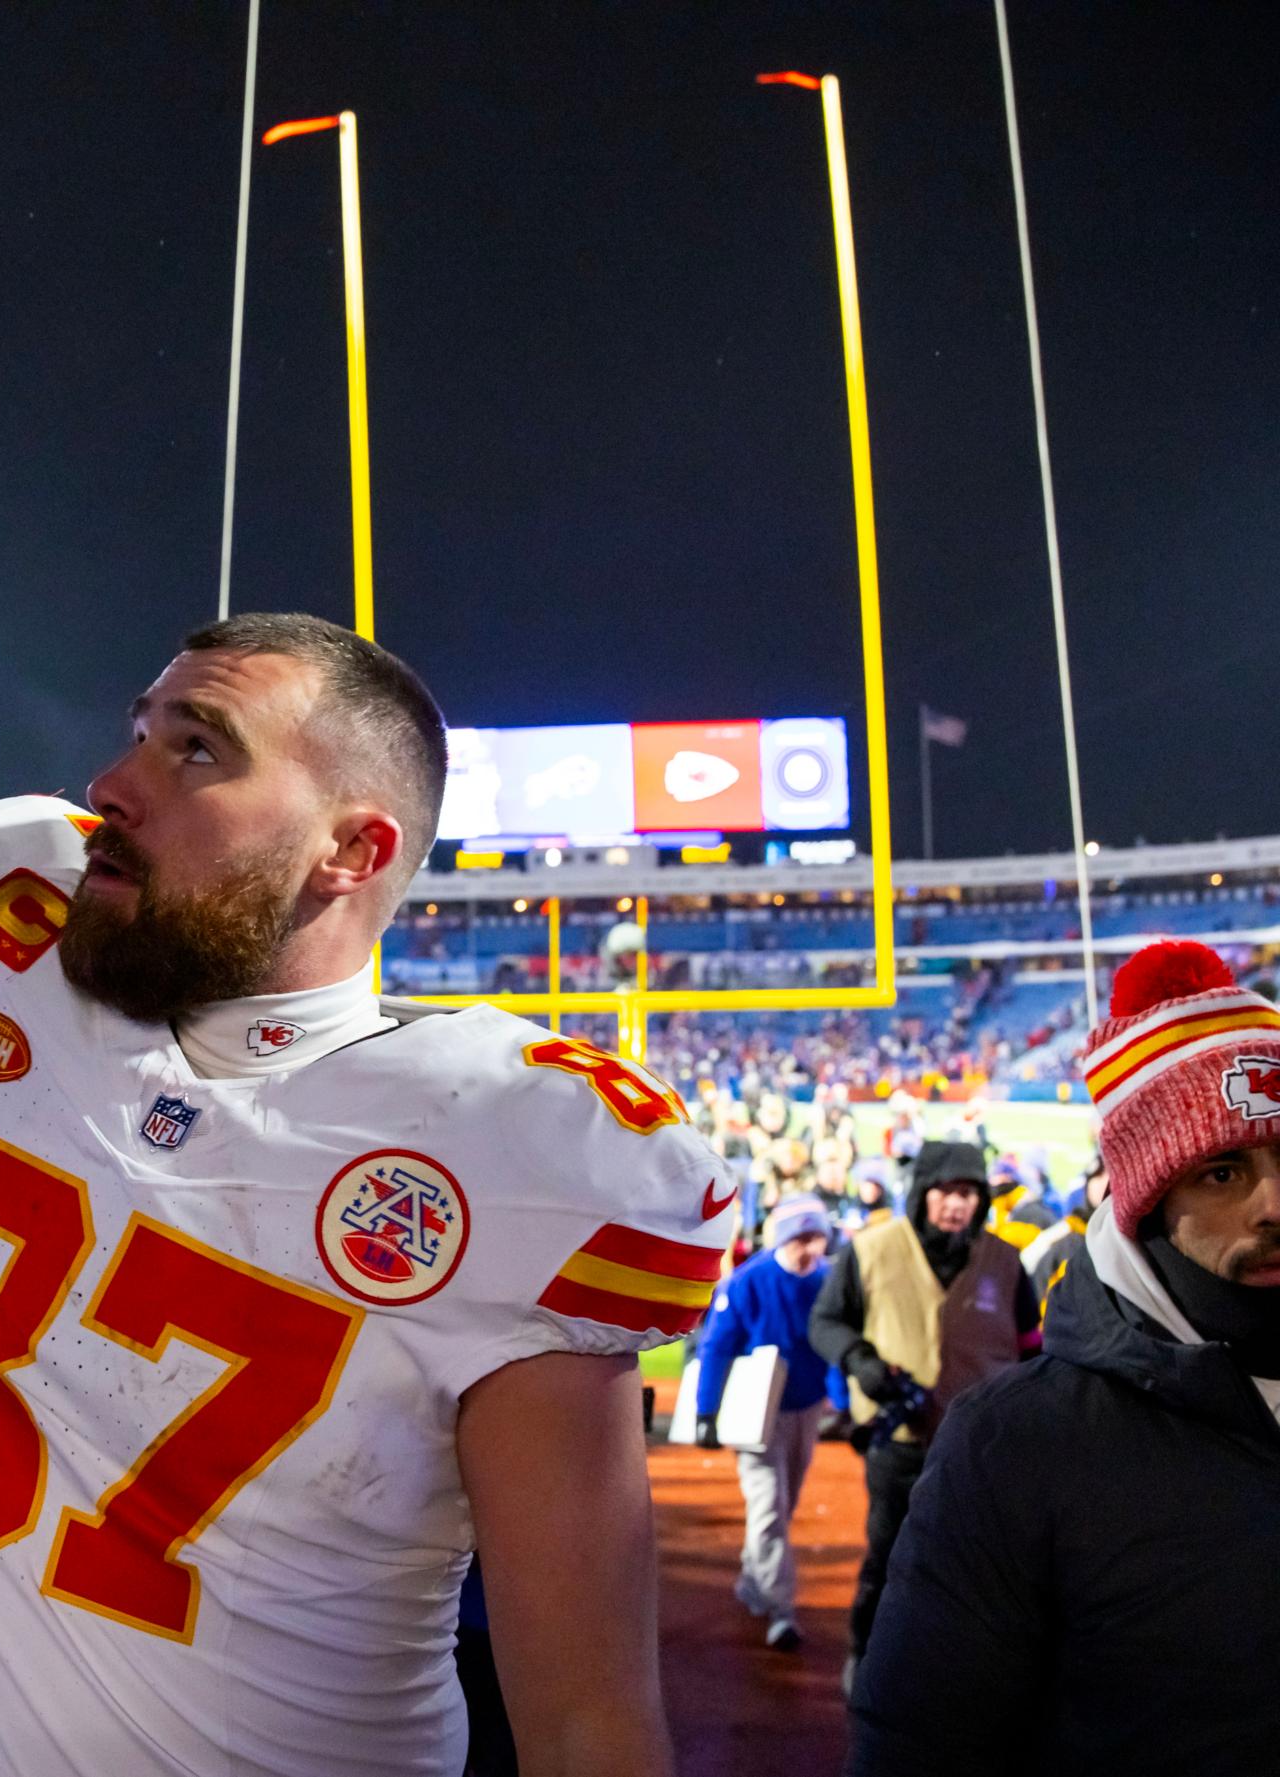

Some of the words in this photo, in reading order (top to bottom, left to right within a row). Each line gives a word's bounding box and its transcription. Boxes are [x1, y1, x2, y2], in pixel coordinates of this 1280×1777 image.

[261, 1026, 294, 1047] KC
[522, 1038, 691, 1136] 8
[146, 1113, 181, 1144] NFL
